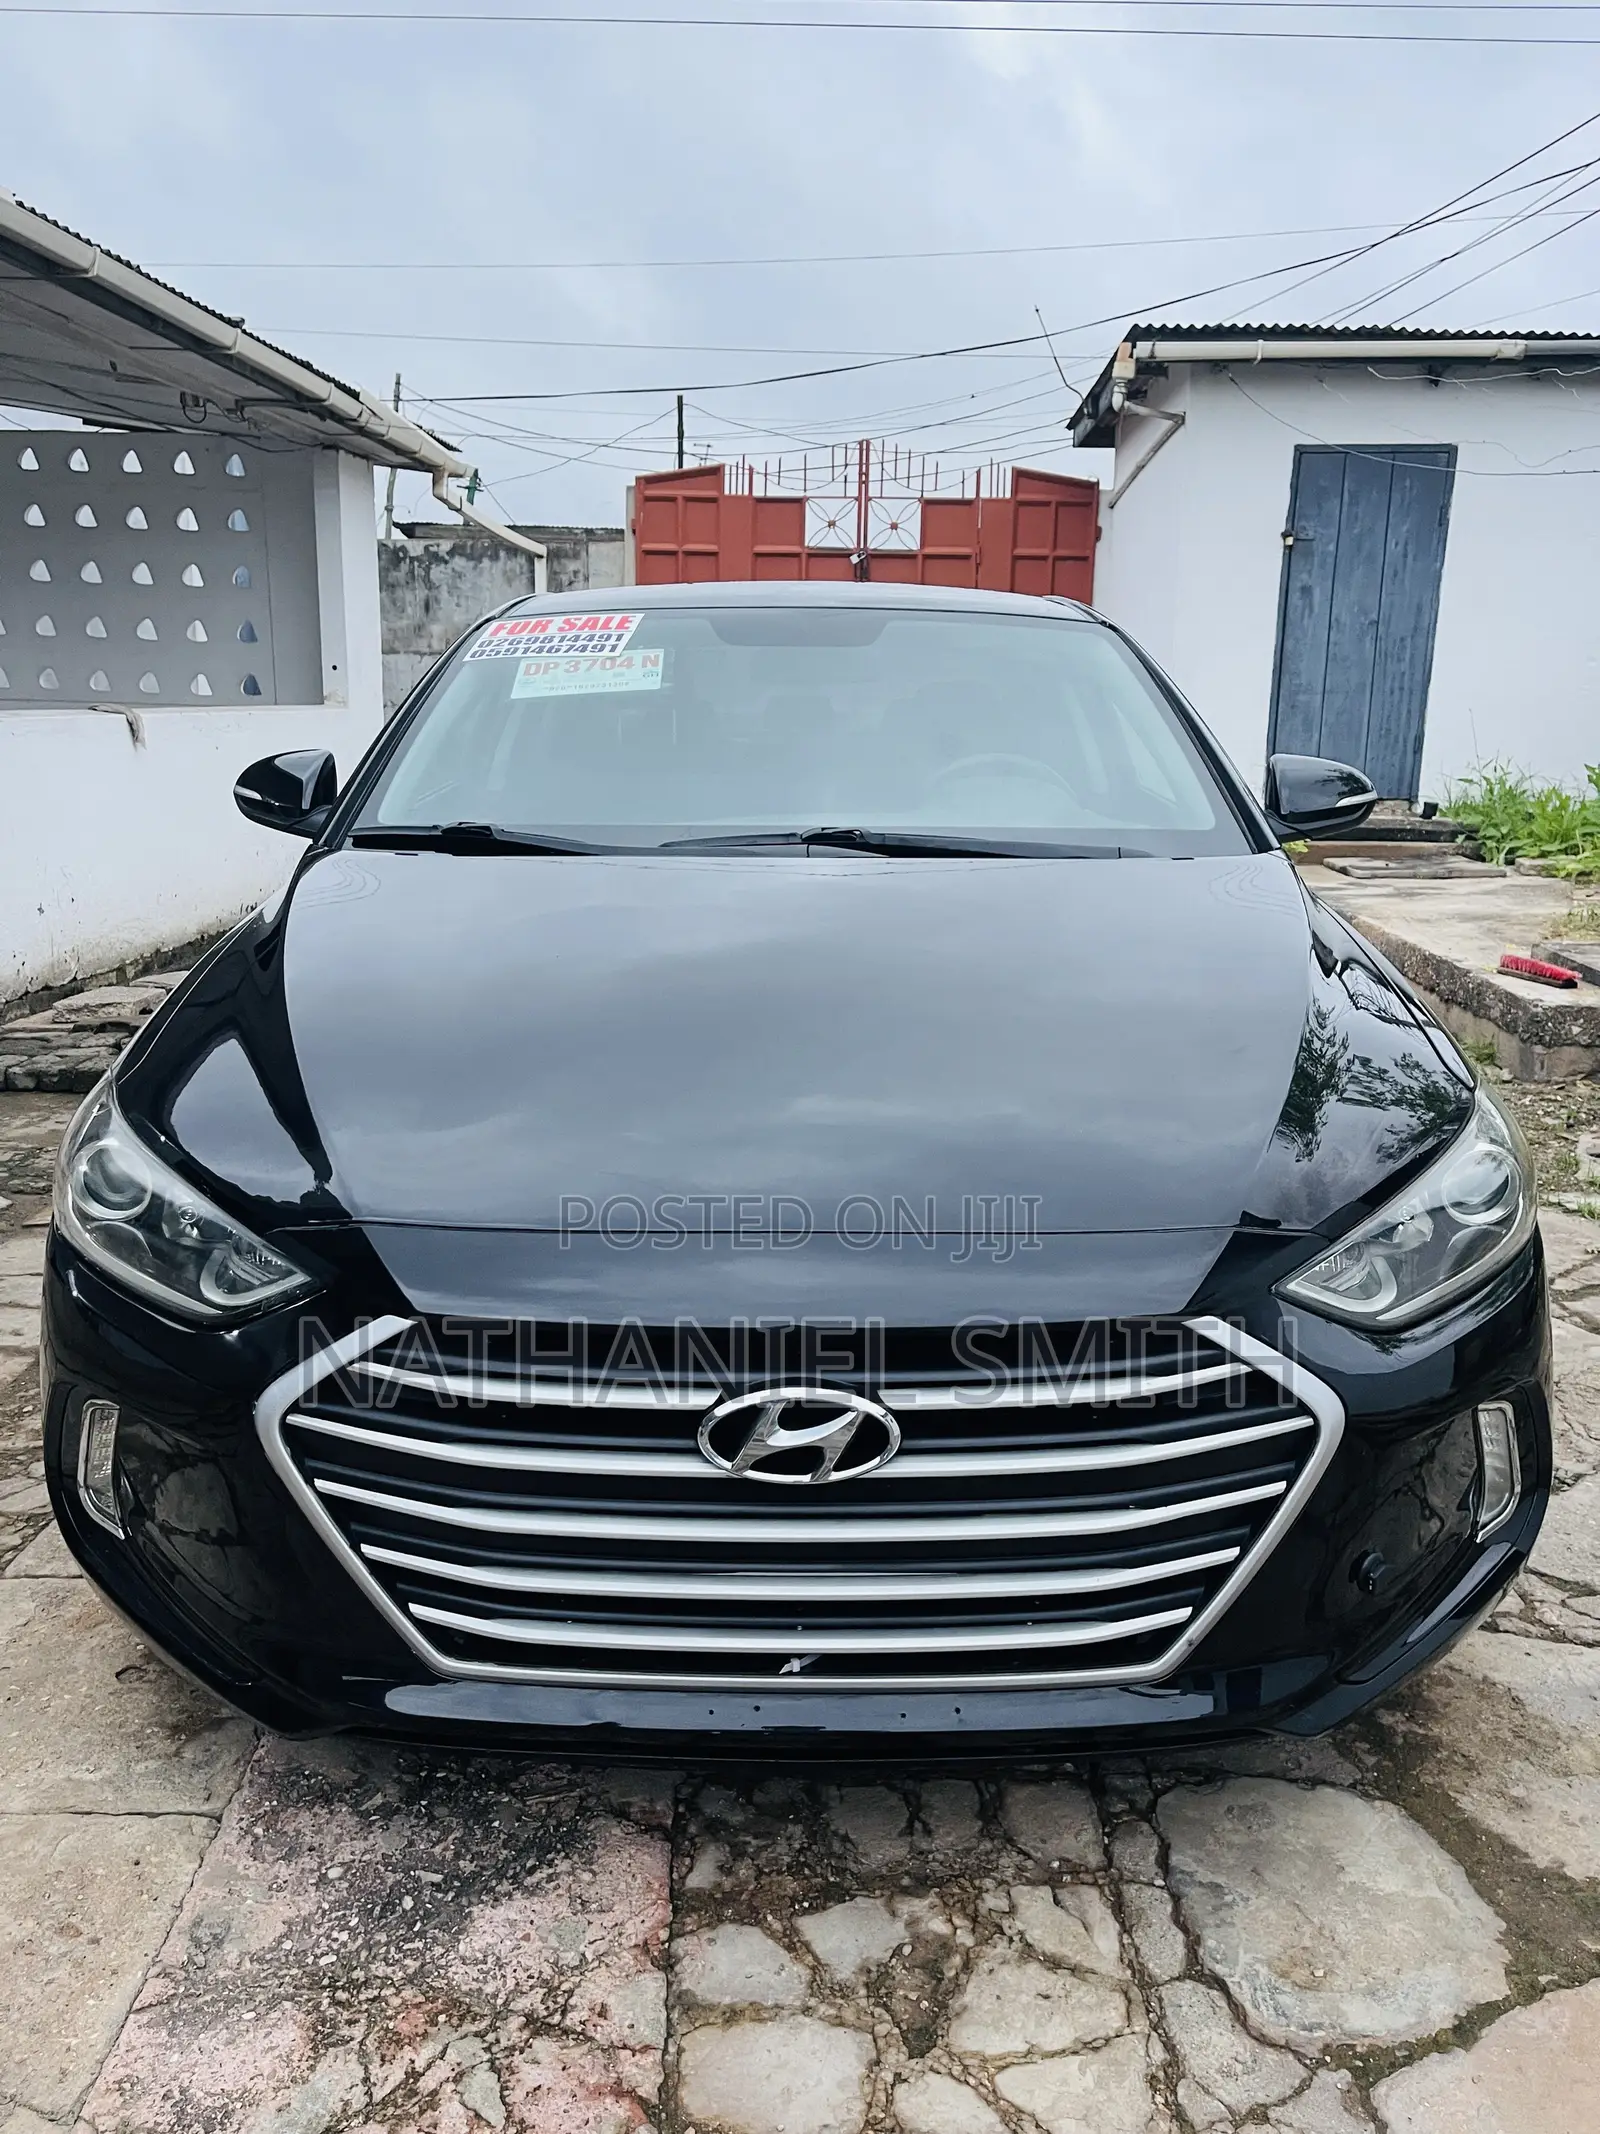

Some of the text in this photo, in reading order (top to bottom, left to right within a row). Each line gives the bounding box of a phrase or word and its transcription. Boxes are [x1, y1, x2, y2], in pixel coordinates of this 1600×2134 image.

[489, 616, 636, 637] FOR SALE
[478, 634, 625, 648] 0269814491
[470, 643, 620, 658] 0591467491
[523, 654, 660, 676] DP 3704 N
